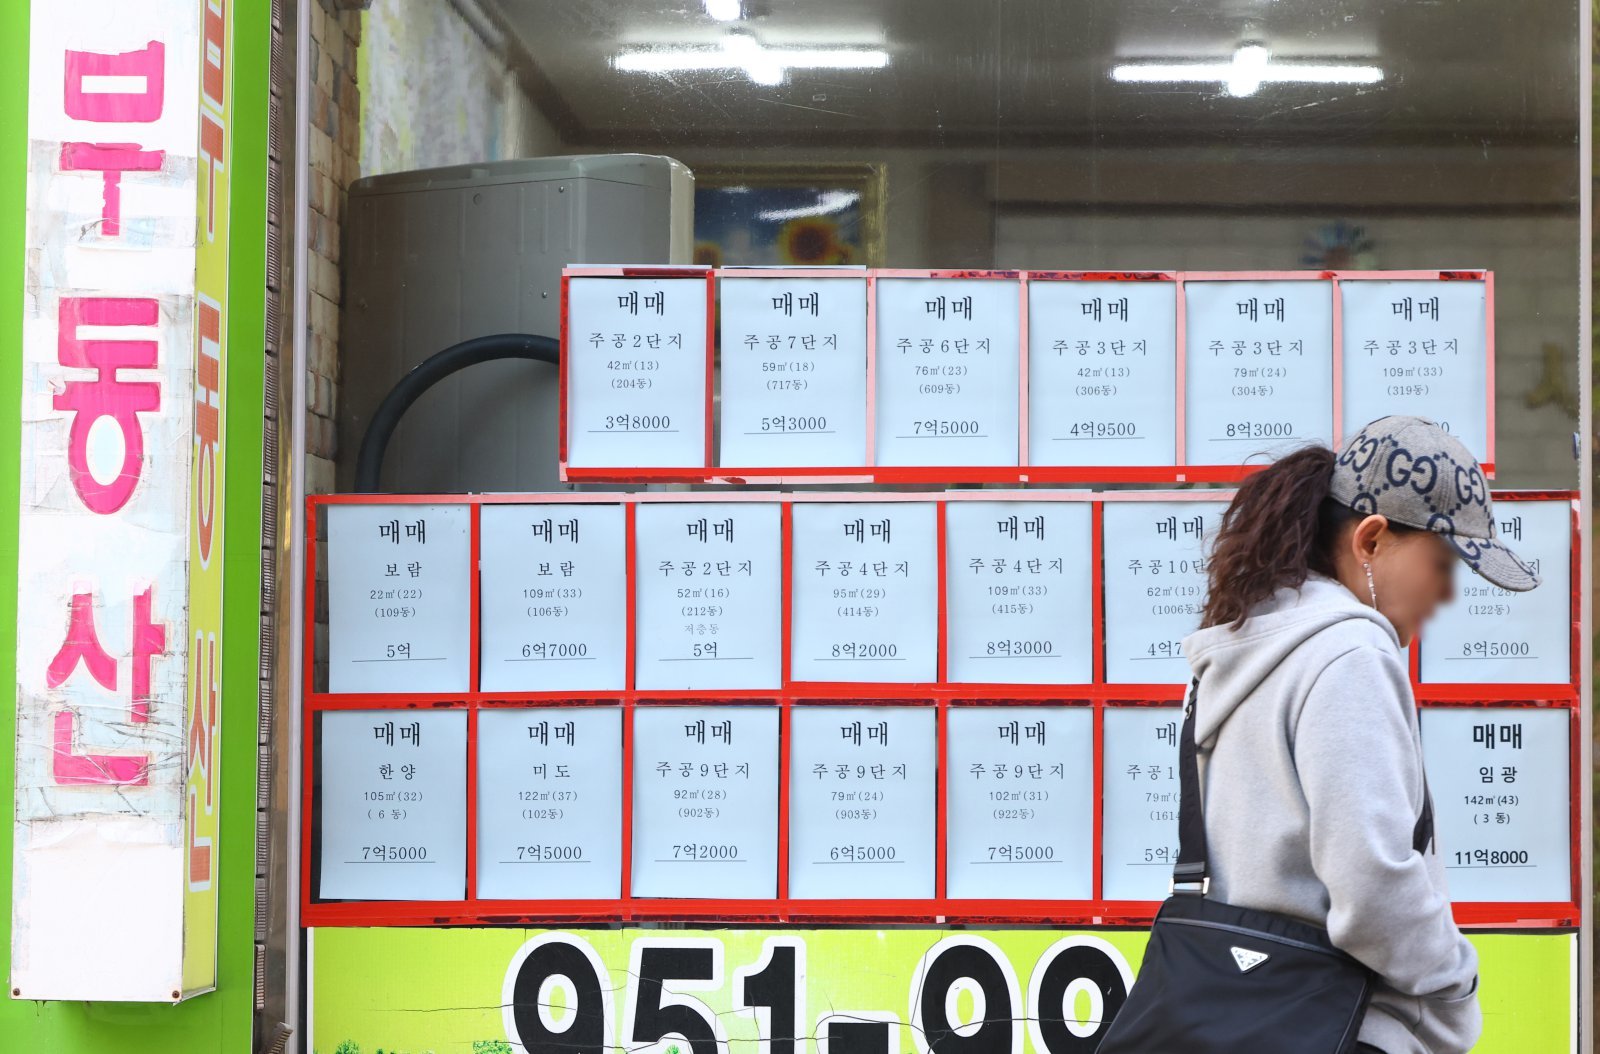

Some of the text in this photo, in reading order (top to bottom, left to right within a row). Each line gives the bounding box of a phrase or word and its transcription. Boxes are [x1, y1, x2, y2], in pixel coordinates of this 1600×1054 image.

[616, 290, 665, 317] 매매
[771, 291, 819, 318] 매매
[924, 295, 973, 322] 매매
[1080, 297, 1129, 323] 매매
[1235, 297, 1285, 323] 매매
[1391, 296, 1439, 323] 매매
[611, 378, 652, 390] (204동)
[766, 379, 808, 391] (717동)
[919, 383, 961, 395] (609동)
[1075, 385, 1117, 396] (306동)
[1231, 385, 1274, 397] (304동)
[1387, 384, 1429, 396] (319동)
[605, 413, 671, 431] 3억8000
[761, 415, 827, 433] 5억3000
[913, 419, 979, 436] 7억5000
[1069, 421, 1136, 440] 4억9500
[1226, 421, 1293, 438] 8억3000
[378, 519, 426, 545] 매매
[531, 518, 579, 545] 매매
[686, 517, 734, 544] 매매
[843, 518, 891, 545] 매매
[996, 515, 1045, 542] 매매
[1155, 515, 1205, 543] 매매
[1500, 515, 1522, 543] 매
[1127, 557, 1208, 576] 주공10단
[374, 606, 416, 618] (109동)
[527, 606, 569, 617] (106동)
[681, 605, 723, 617] (212동)
[837, 606, 879, 618] (414동)
[992, 603, 1034, 615] (415동)
[1468, 604, 1510, 616] (122동)
[386, 642, 411, 659] 5억
[522, 641, 588, 659] 6억7000
[693, 641, 717, 659] 5억
[831, 641, 897, 659] 8억2000
[986, 639, 1053, 657] 8억3000
[1147, 640, 1185, 659] 4억7
[1462, 640, 1530, 658] 8억5000
[372, 721, 420, 748] 매매
[527, 720, 575, 747] 매매
[683, 719, 732, 746] 매매
[840, 720, 888, 748] 매매
[997, 720, 1046, 747] 매매
[1154, 721, 1177, 748] 매
[1472, 723, 1523, 750] 매매
[1126, 764, 1175, 781] 주공1
[522, 808, 564, 820] (102동)
[678, 807, 720, 819] (902동)
[835, 809, 877, 820] (903동)
[993, 808, 1035, 820] (922동)
[1149, 807, 1182, 823] (1614
[361, 844, 428, 863] 7억5000
[516, 844, 583, 862] 7억5000
[672, 843, 738, 862] 7억2000
[830, 844, 896, 863] 6억5000
[988, 844, 1054, 862] 7억5000
[1143, 846, 1181, 865] 5억4
[1455, 848, 1529, 868] 11억8000
[510, 941, 1129, 1054] 951-99
